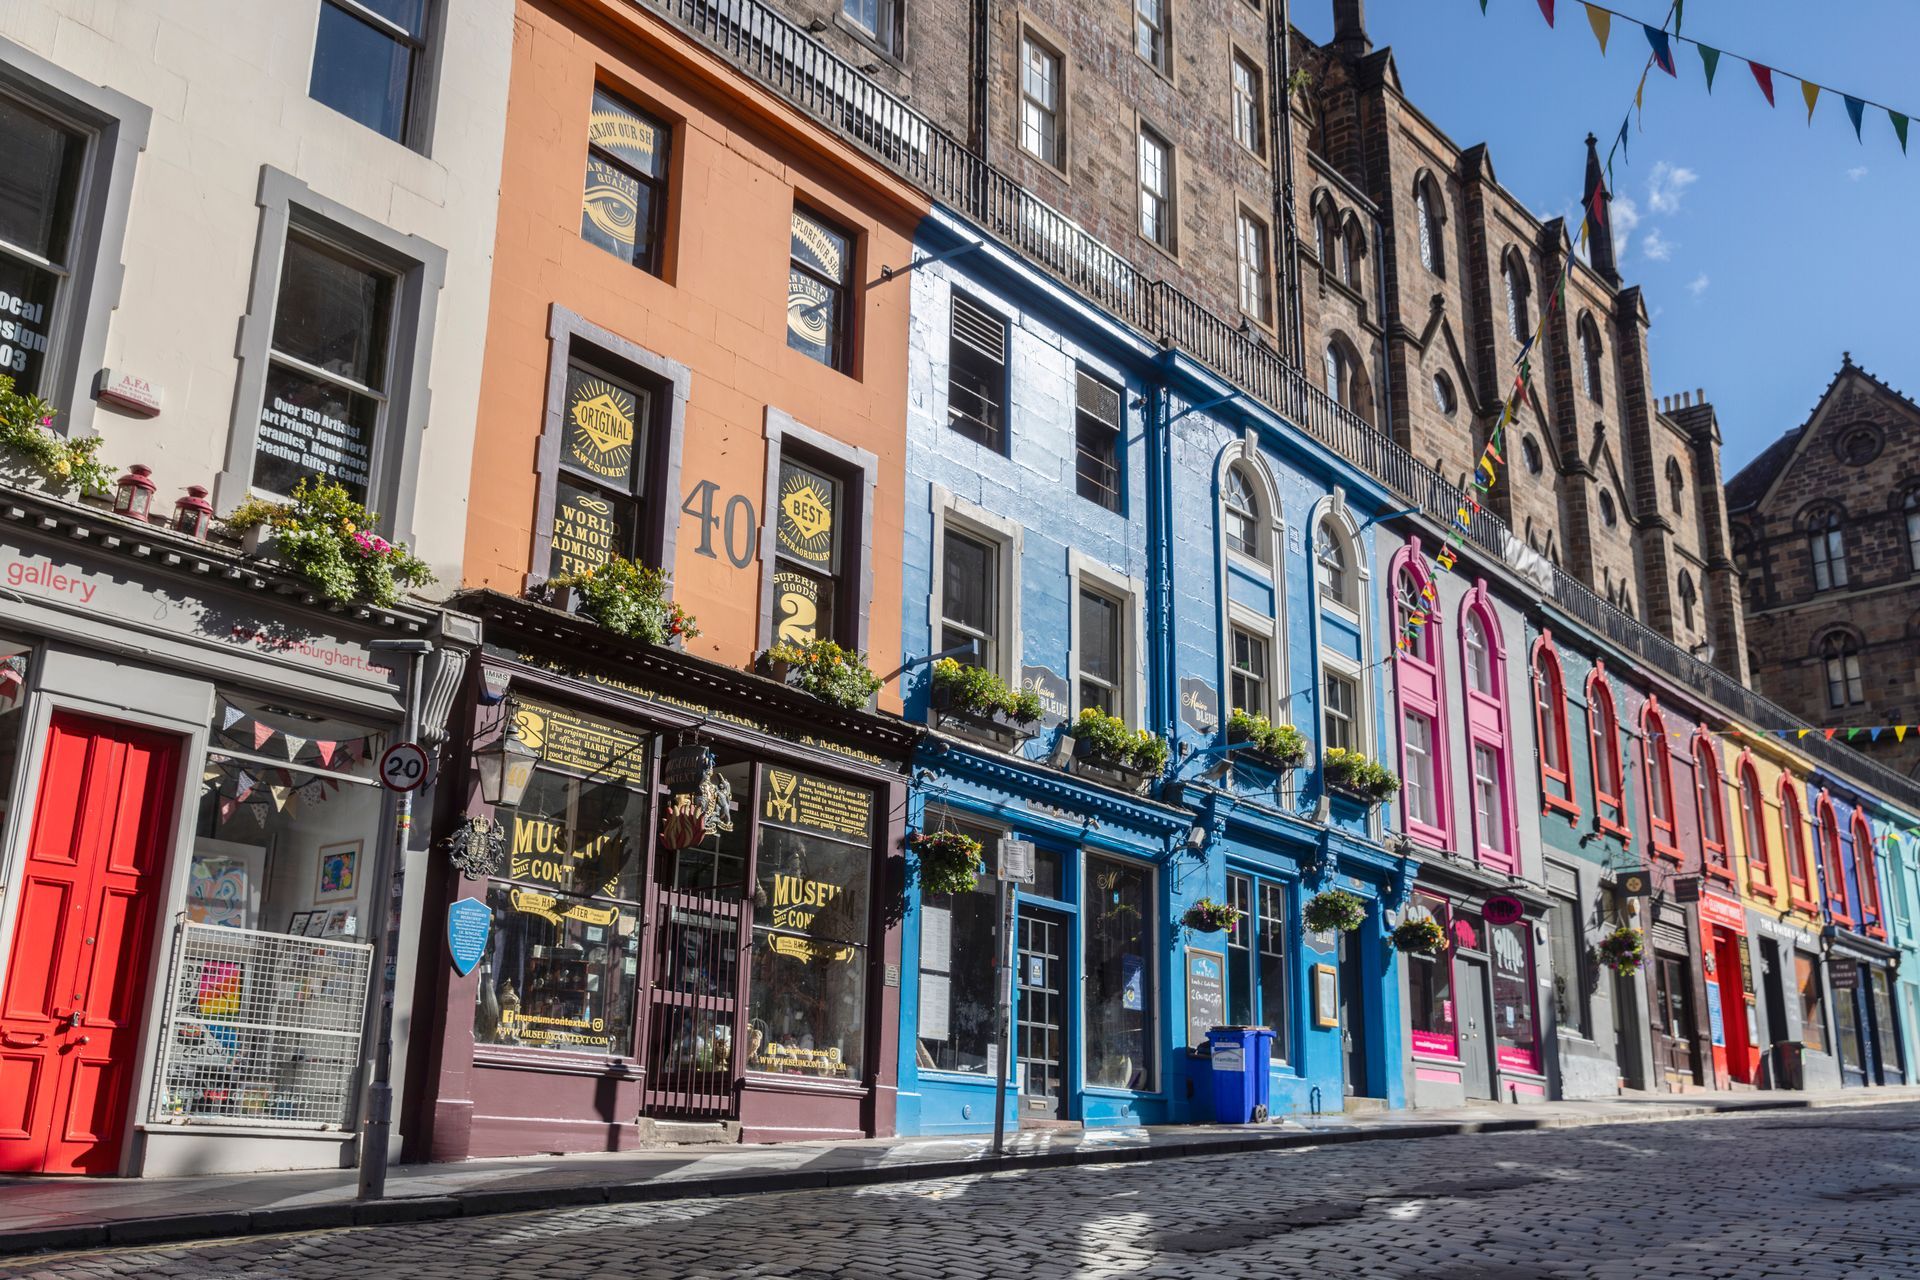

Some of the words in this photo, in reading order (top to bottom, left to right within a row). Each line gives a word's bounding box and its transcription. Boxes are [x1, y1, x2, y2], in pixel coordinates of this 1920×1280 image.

[619, 122, 638, 140] OUR
[588, 162, 602, 172] AN
[605, 165, 628, 182] EYE
[597, 173, 637, 197] QUALIT
[816, 239, 830, 259] OUR
[800, 275, 818, 290] EYE
[0, 320, 47, 353] sign
[274, 397, 300, 417] Over
[301, 407, 321, 425] 150
[321, 414, 361, 439] Artists!
[580, 404, 629, 441] ORIGINAL
[262, 408, 280, 426] Art
[280, 413, 315, 439] Prints,
[315, 427, 368, 458] Jewellery,
[256, 437, 300, 463] Creative
[301, 453, 328, 473] Gifts
[328, 465, 337, 476] &
[338, 466, 369, 487] Cards
[310, 441, 368, 472] Homeware
[682, 480, 756, 569] 40
[793, 499, 823, 525] BEST
[560, 554, 599, 577] FRE
[7, 561, 97, 603] gallery
[550, 722, 563, 734] The
[564, 728, 589, 741] original
[589, 733, 601, 744] and
[602, 736, 613, 747] best
[548, 742, 587, 757] merchandise
[590, 751, 597, 760] to
[599, 753, 610, 763] the
[630, 763, 642, 771] and
[548, 751, 562, 761] good
[564, 753, 571, 762] of
[549, 733, 556, 741] of
[585, 741, 610, 754] HARRY
[614, 746, 642, 763] POTER
[387, 756, 421, 779] 20
[508, 766, 527, 788] 40
